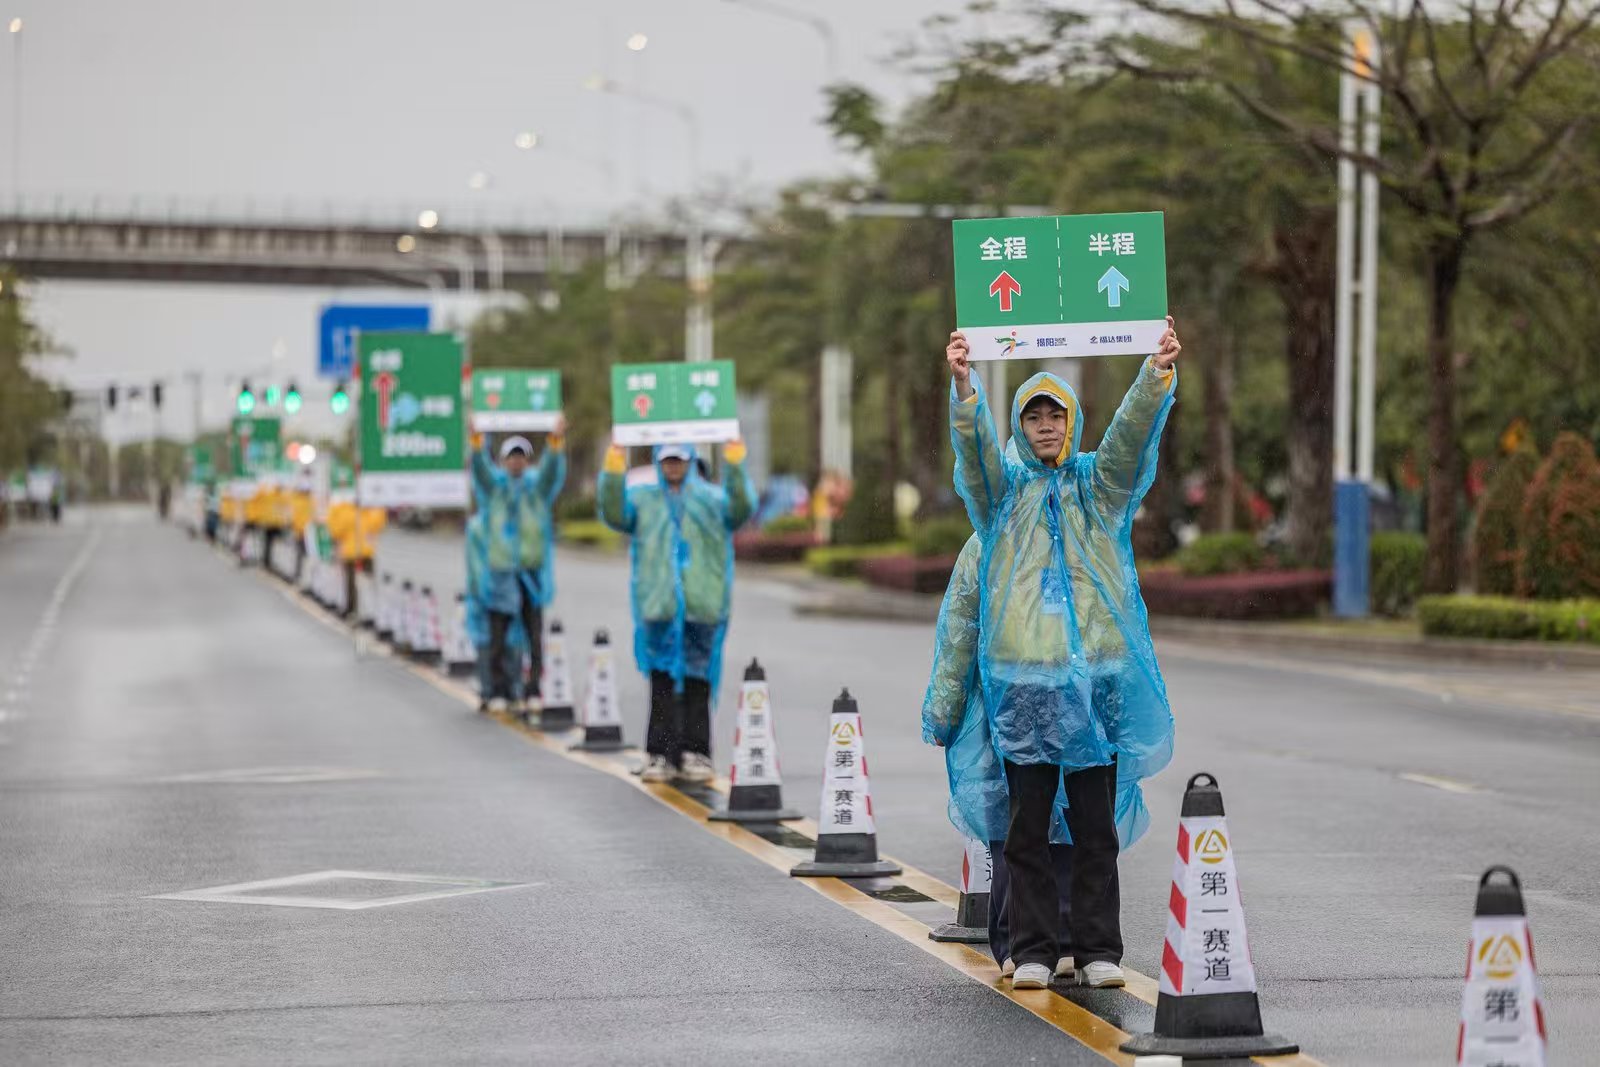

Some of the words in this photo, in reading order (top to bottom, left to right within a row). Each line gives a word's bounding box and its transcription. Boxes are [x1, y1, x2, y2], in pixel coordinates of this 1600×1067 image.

[980, 236, 1027, 260] 全程
[1089, 232, 1136, 256] 半程
[833, 750, 854, 826] 第一赛道
[1200, 871, 1232, 982] 第一赛道
[1485, 989, 1519, 1067] 第一
